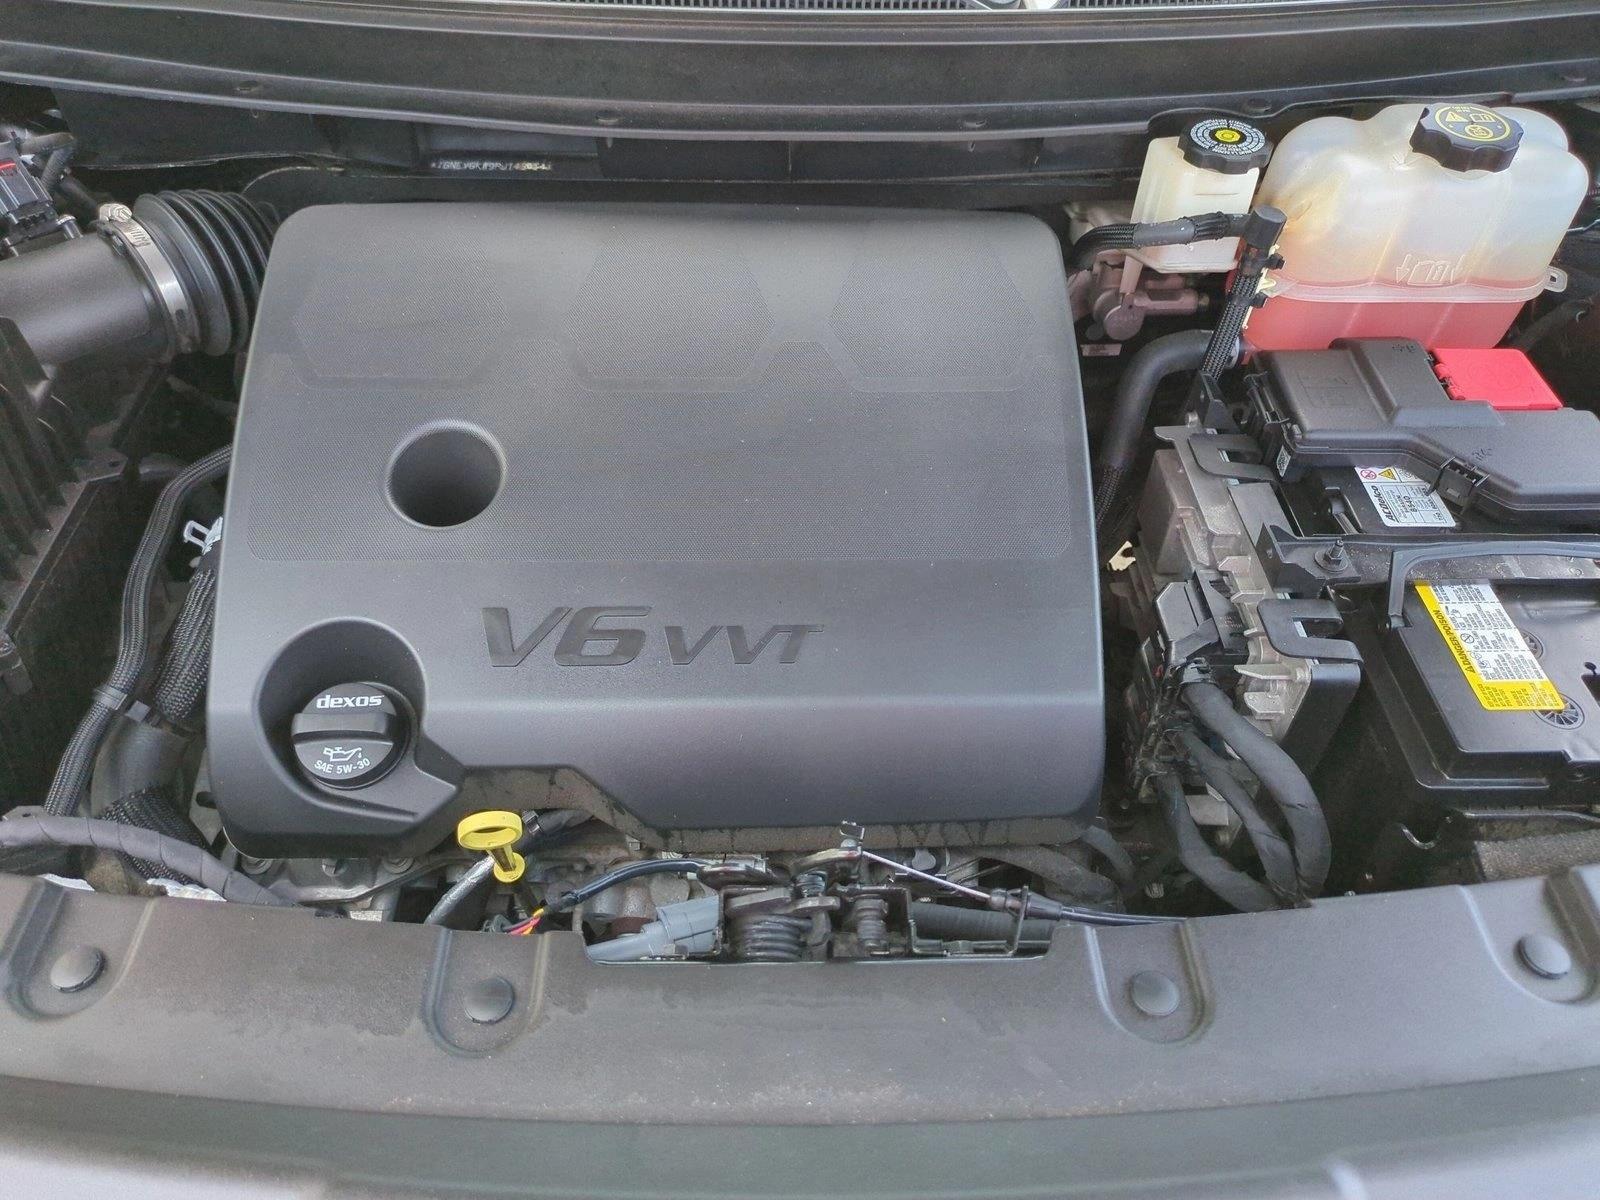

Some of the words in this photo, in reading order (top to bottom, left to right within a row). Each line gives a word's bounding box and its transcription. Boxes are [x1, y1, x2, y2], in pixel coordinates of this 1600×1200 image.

[1371, 485, 1395, 522] ACDelco
[481, 607, 652, 667] V6
[665, 624, 825, 665] VVT
[317, 694, 383, 709] dexos
[314, 760, 333, 773] SAE
[336, 758, 371, 774] 5W-30
